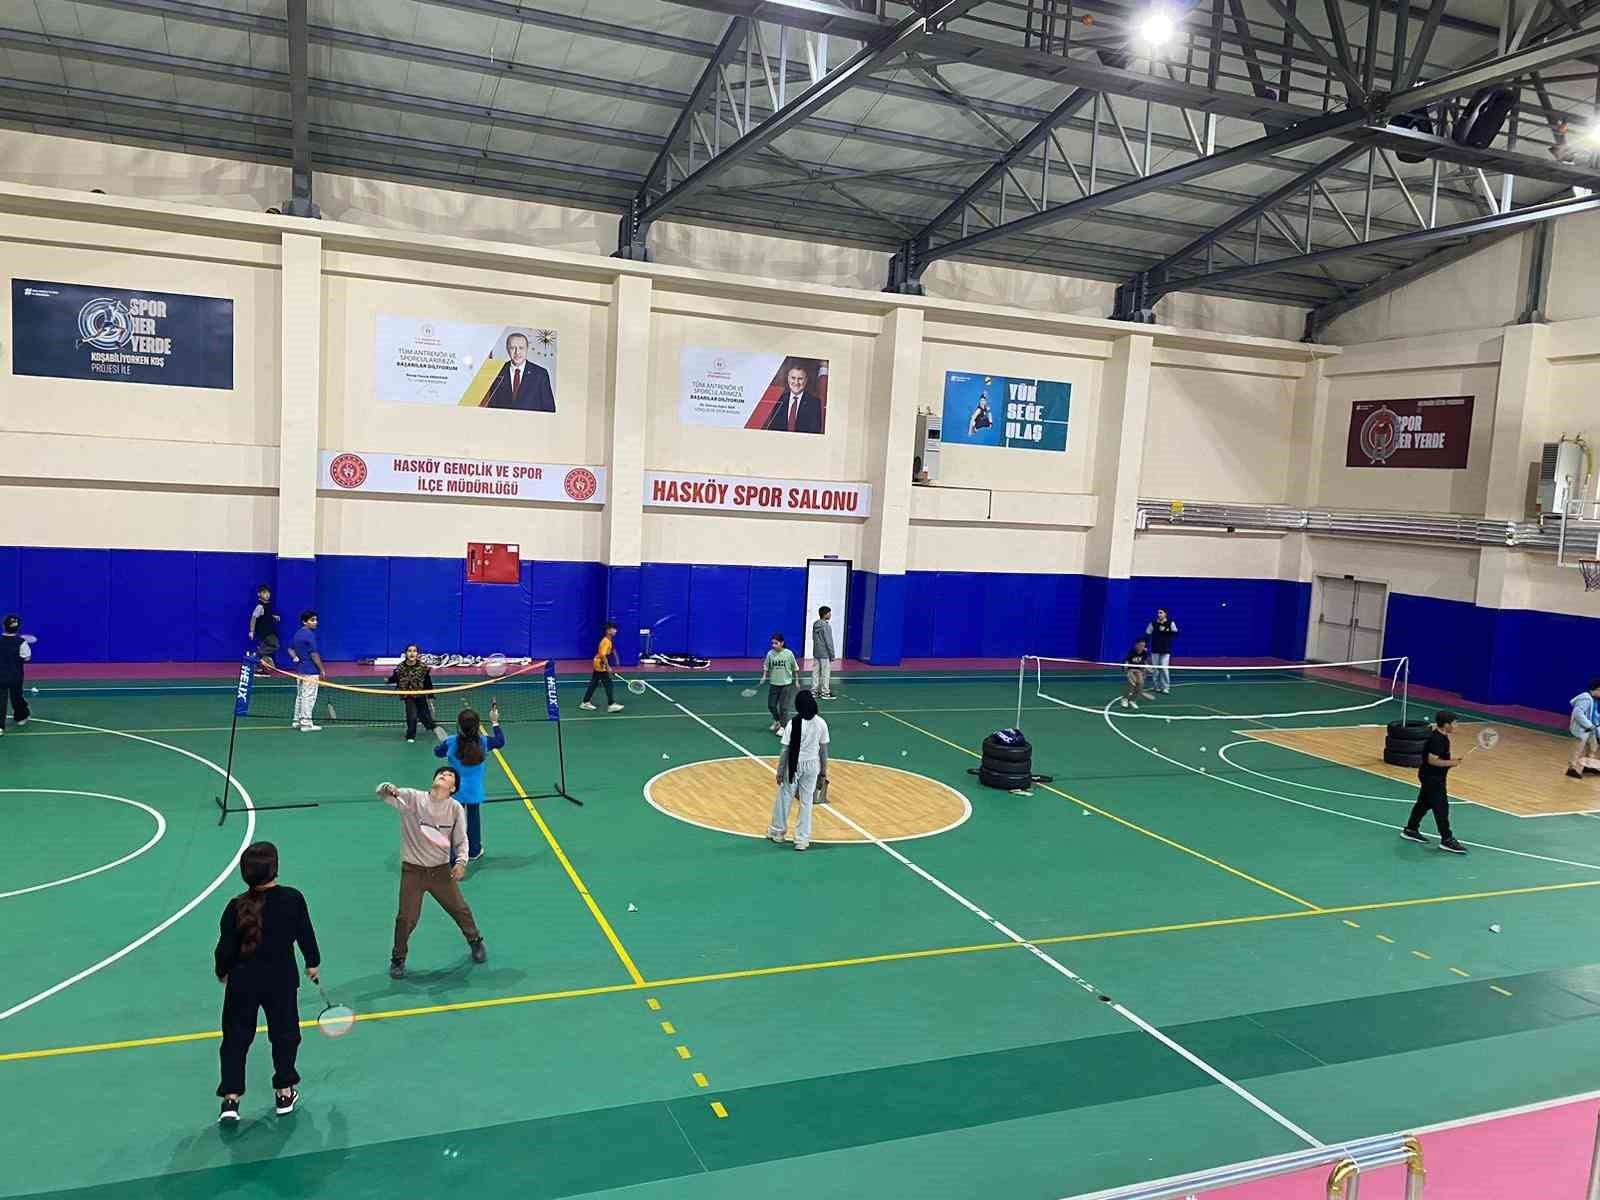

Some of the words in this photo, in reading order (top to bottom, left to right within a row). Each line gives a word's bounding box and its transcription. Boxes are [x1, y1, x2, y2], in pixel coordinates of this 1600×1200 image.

[130, 298, 167, 318] SPOR
[132, 317, 156, 335] HER
[131, 335, 172, 355] YERDE
[398, 346, 413, 355] TÜM
[150, 356, 165, 368] KOŞ
[692, 380, 705, 389] TÜM
[1005, 422, 1043, 442] ULAŞ
[1414, 432, 1446, 449] YERDE
[393, 458, 440, 474] HASKÖY
[443, 461, 492, 478] GENÇLİK
[495, 465, 510, 478] VE
[512, 466, 542, 480] SPOR
[417, 476, 443, 494] İLÇE
[447, 478, 519, 497] MÜDÜRLÜĞÜ
[652, 478, 729, 505] HASKÖY
[733, 485, 782, 507] SPOR
[787, 487, 859, 512] SALONU
[237, 664, 251, 704] HELIX
